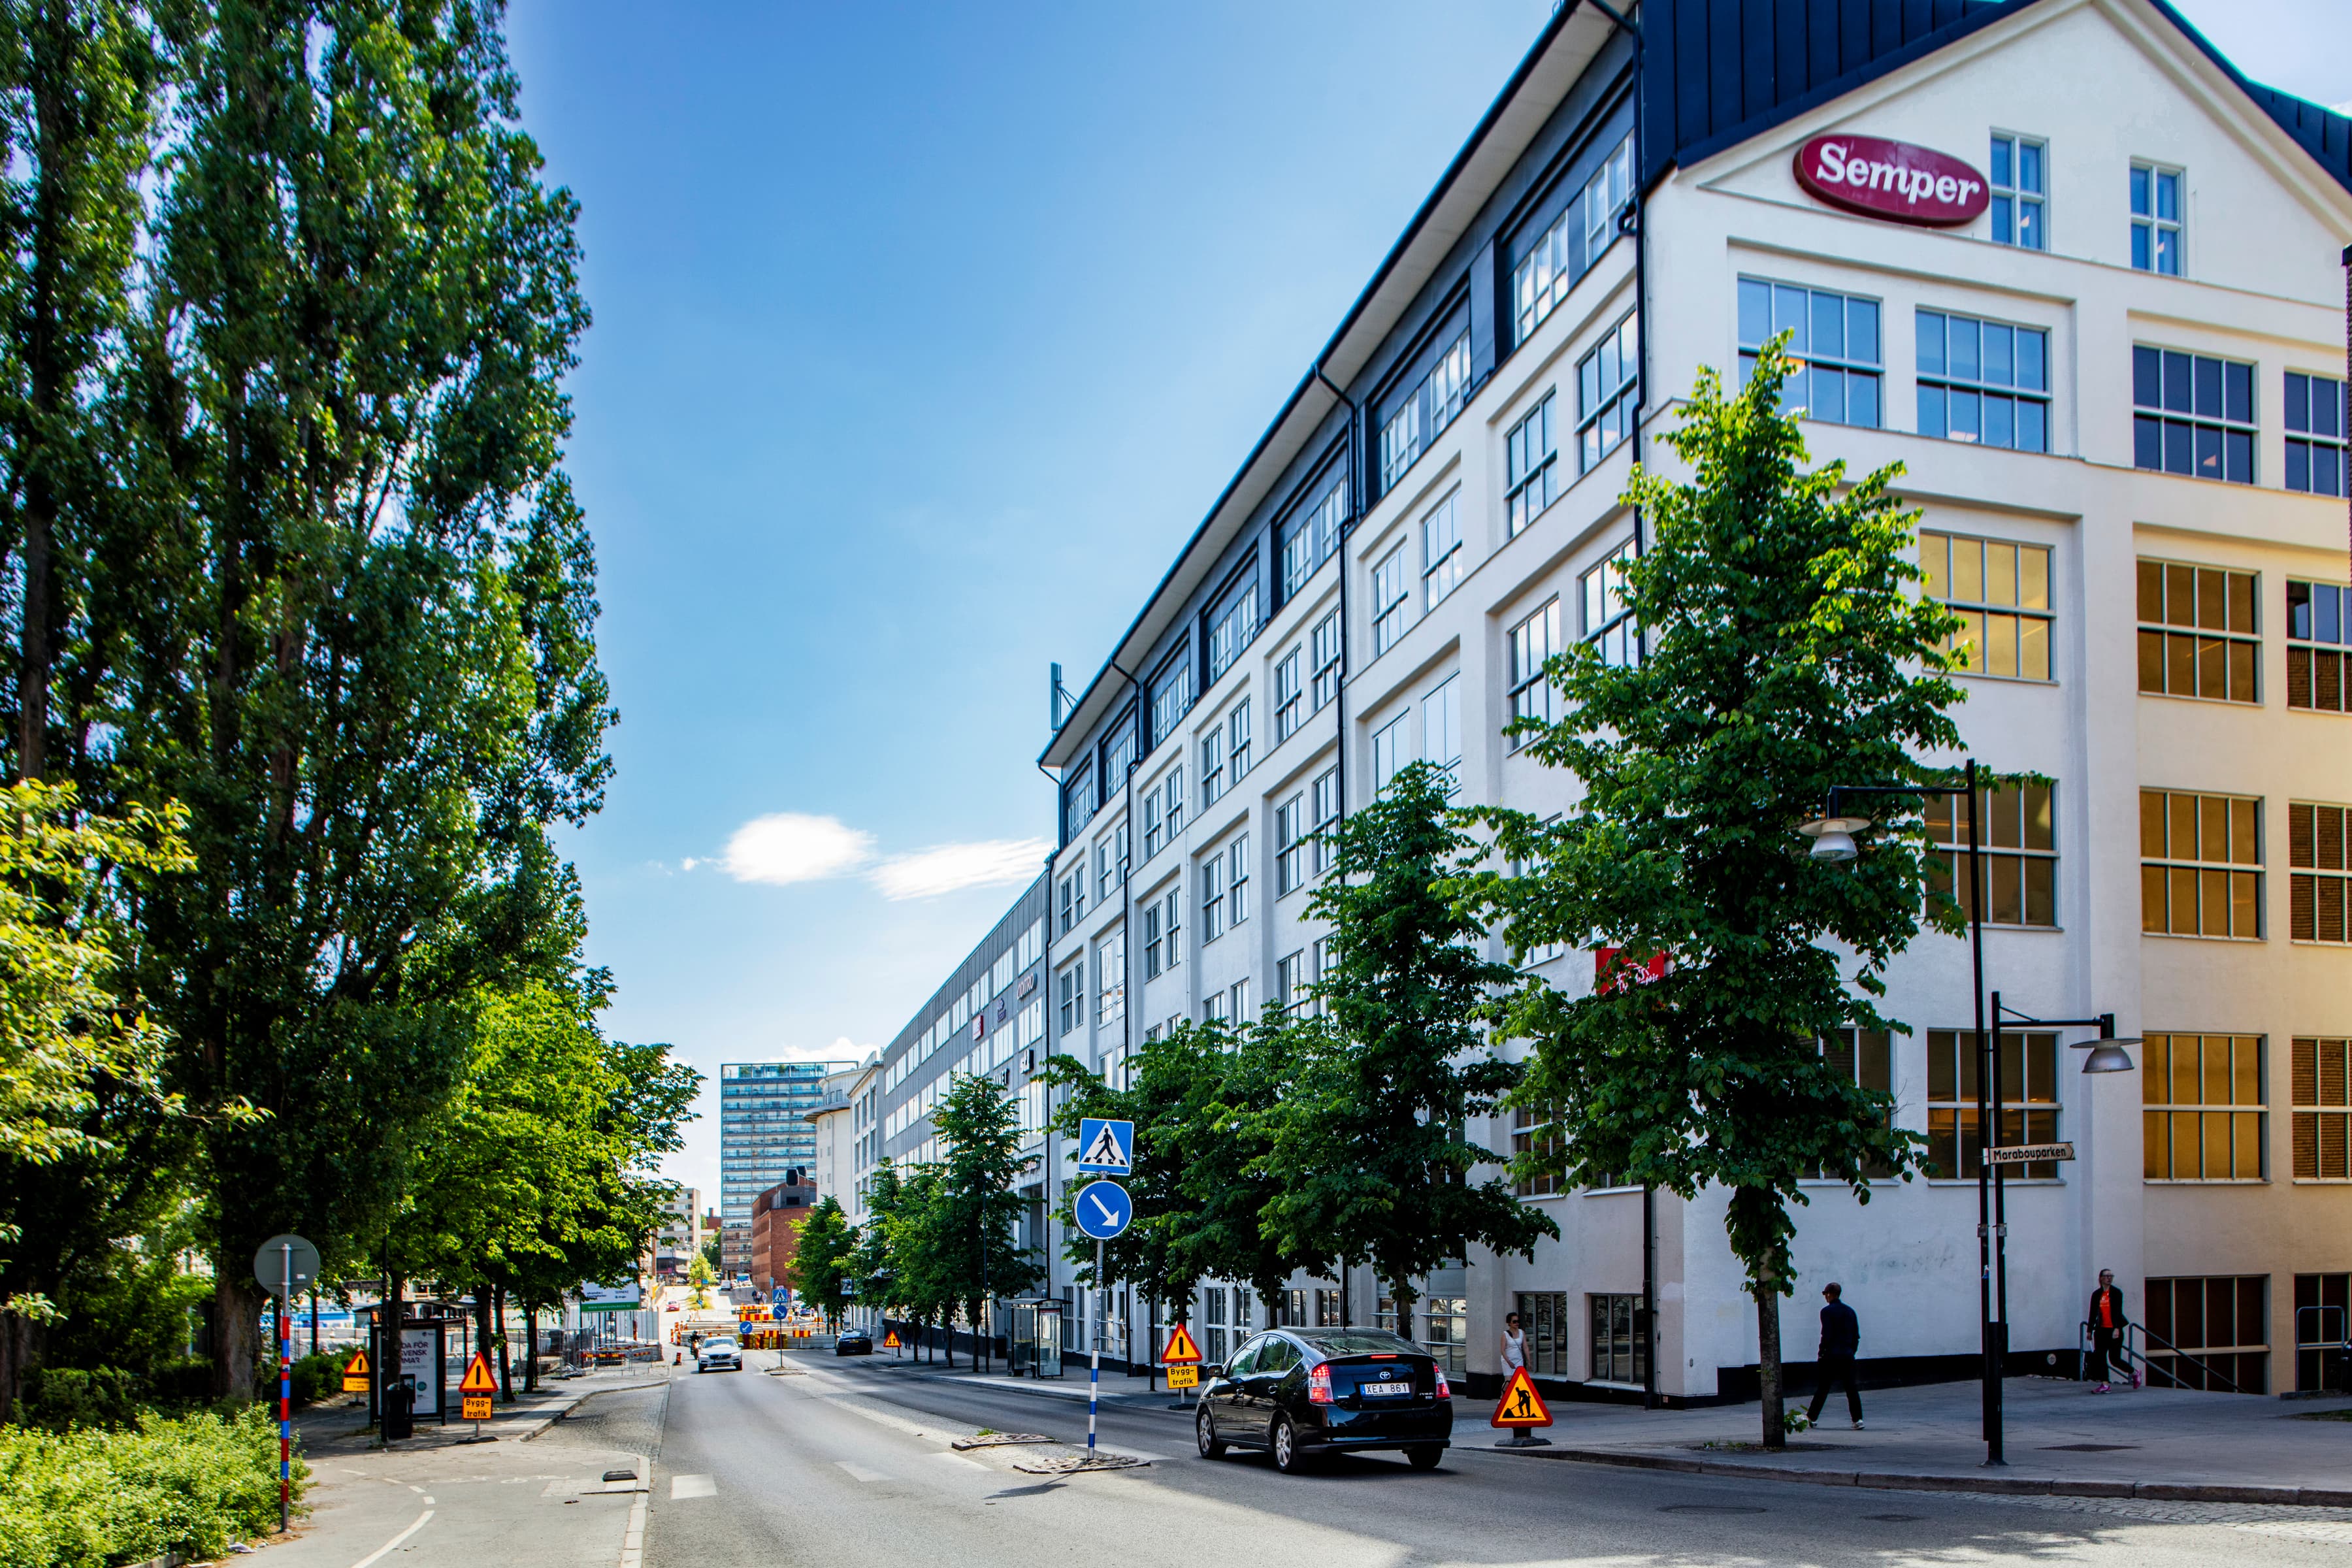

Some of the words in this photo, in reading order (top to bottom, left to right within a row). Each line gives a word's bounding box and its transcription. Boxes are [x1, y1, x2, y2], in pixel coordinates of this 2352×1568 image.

[1816, 142, 1980, 206] Semper
[1993, 1147, 2066, 1160] Marabouparken
[1366, 1384, 1384, 1393] XEA
[1390, 1384, 1407, 1392] 861
[466, 1398, 489, 1407] Bygg-
